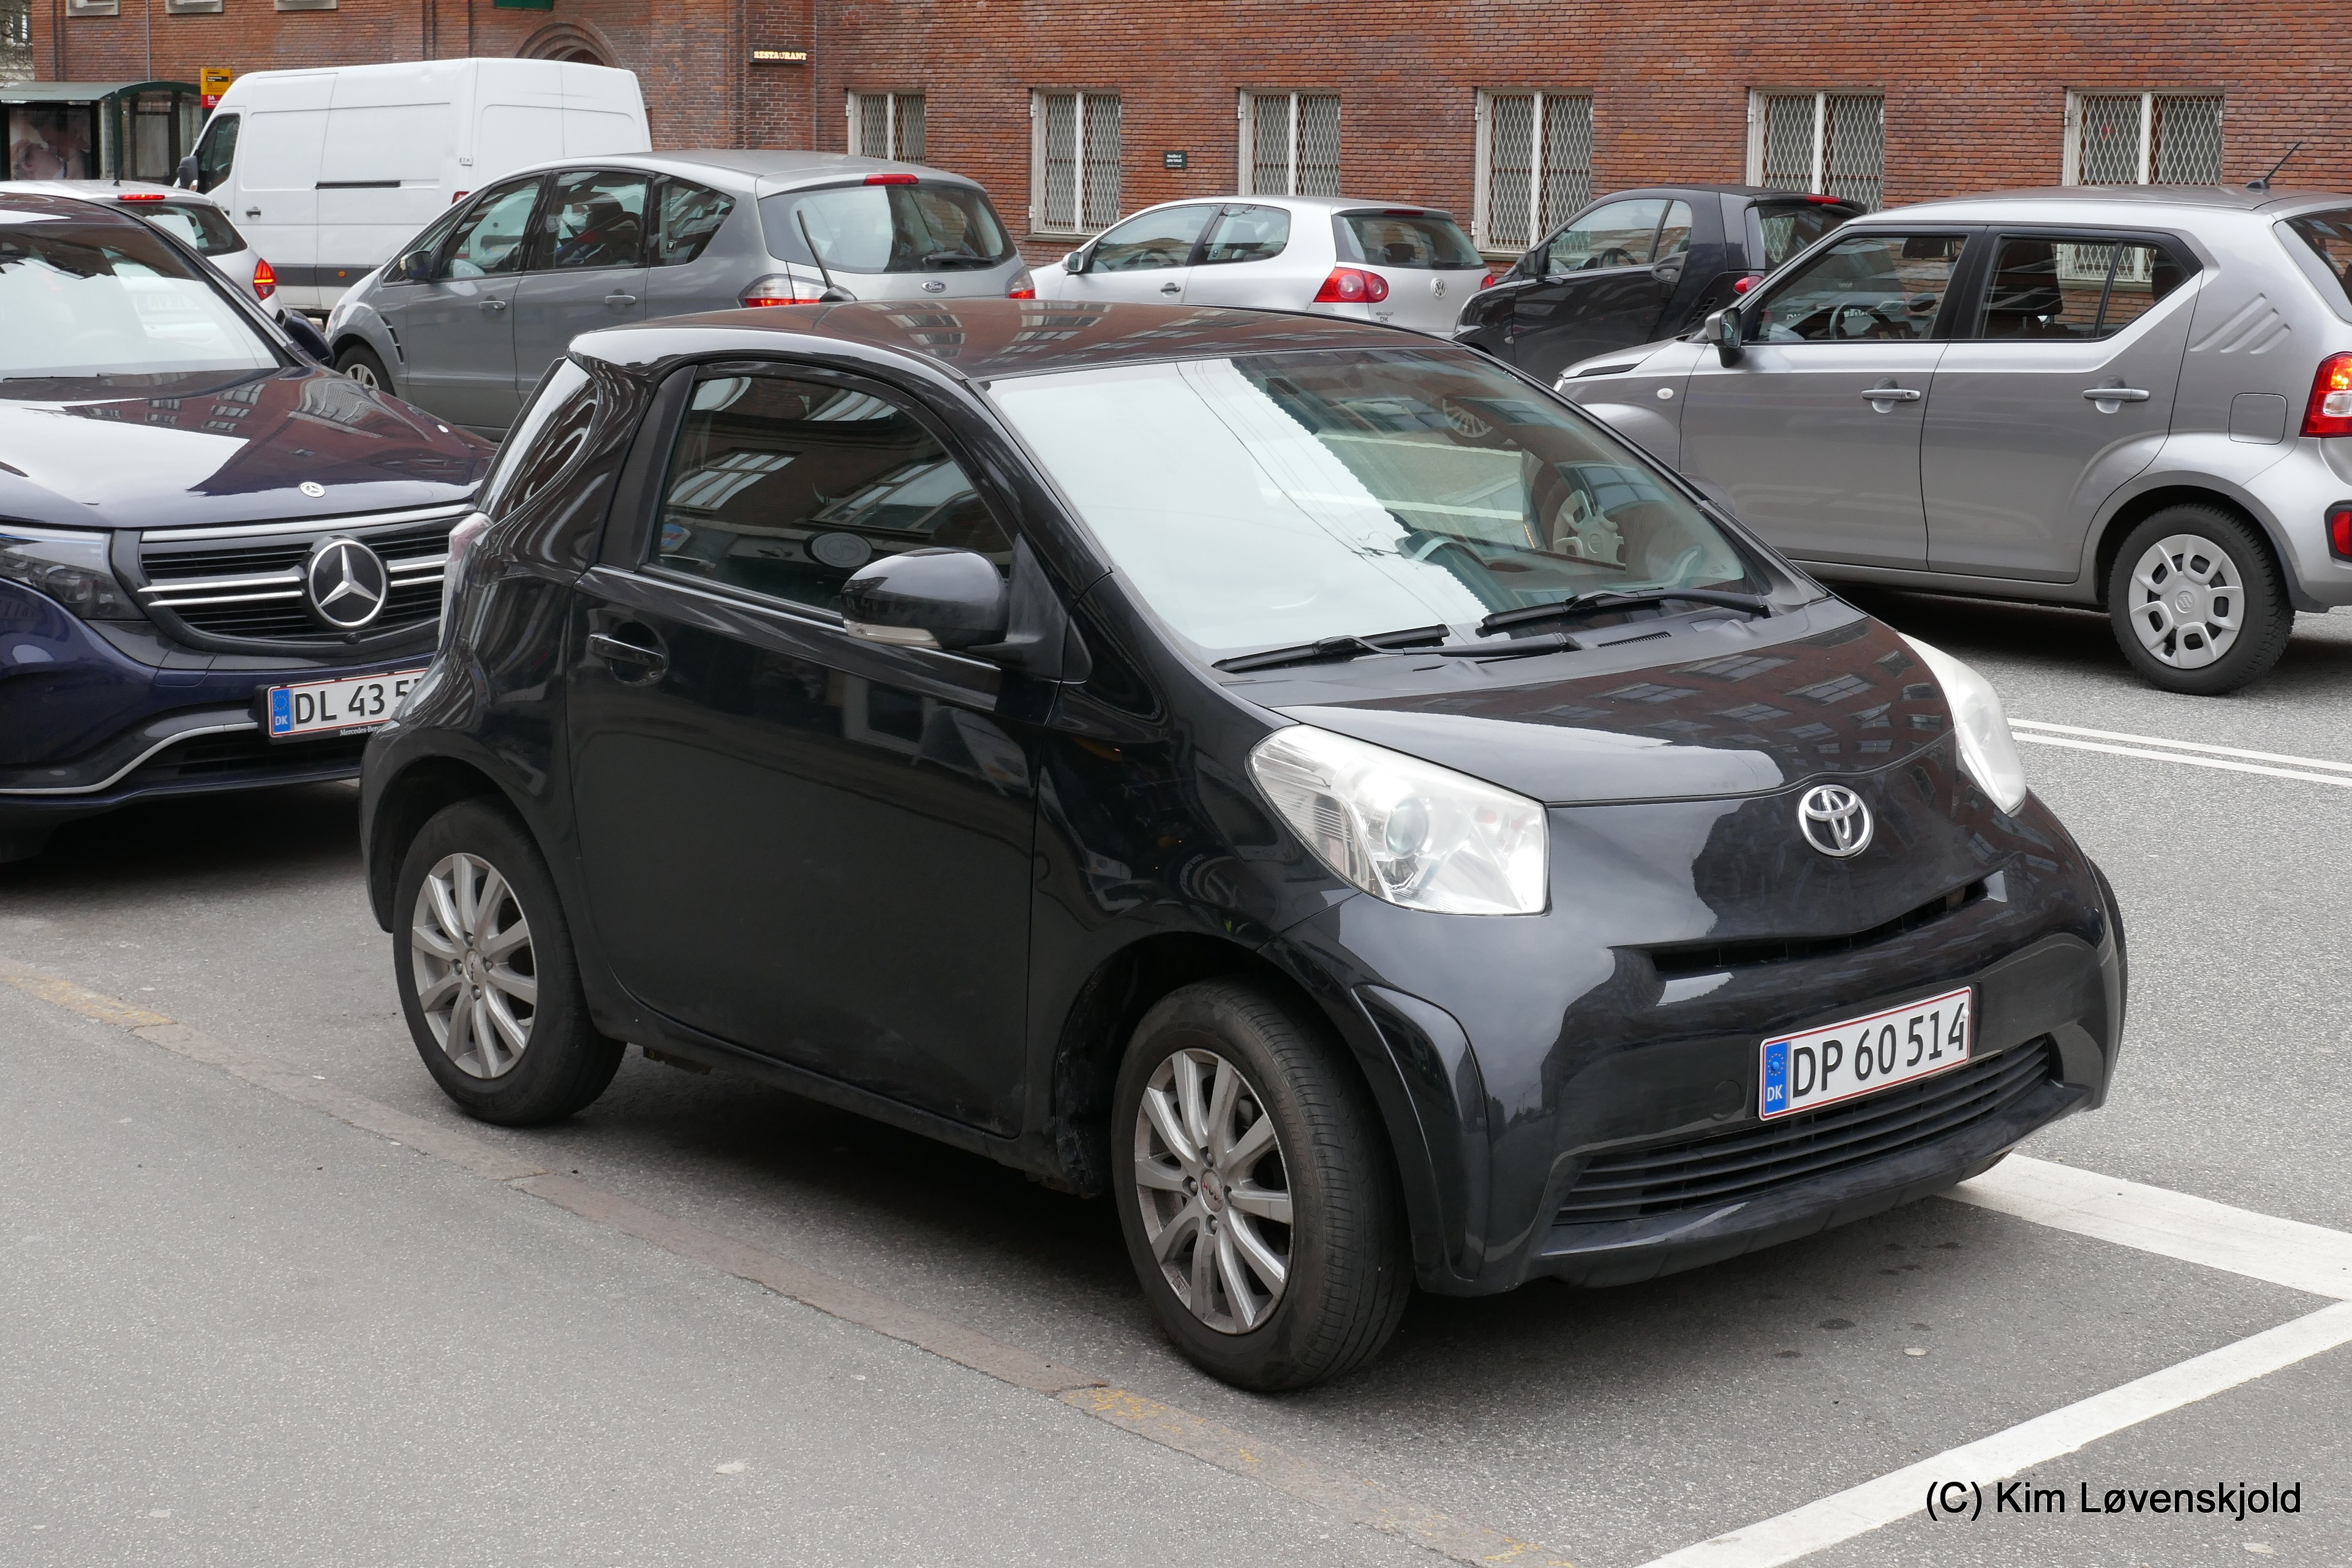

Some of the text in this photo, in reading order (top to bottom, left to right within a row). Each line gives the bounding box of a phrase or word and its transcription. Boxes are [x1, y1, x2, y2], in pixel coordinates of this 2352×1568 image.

[753, 51, 807, 60] RESTAURANT
[295, 690, 337, 725] DL
[349, 684, 385, 717] 43
[276, 715, 288, 726] DK
[339, 726, 381, 736] Mercedes-Ben
[1792, 1002, 1965, 1098] DP 60 514
[1767, 1084, 1783, 1102] DK
